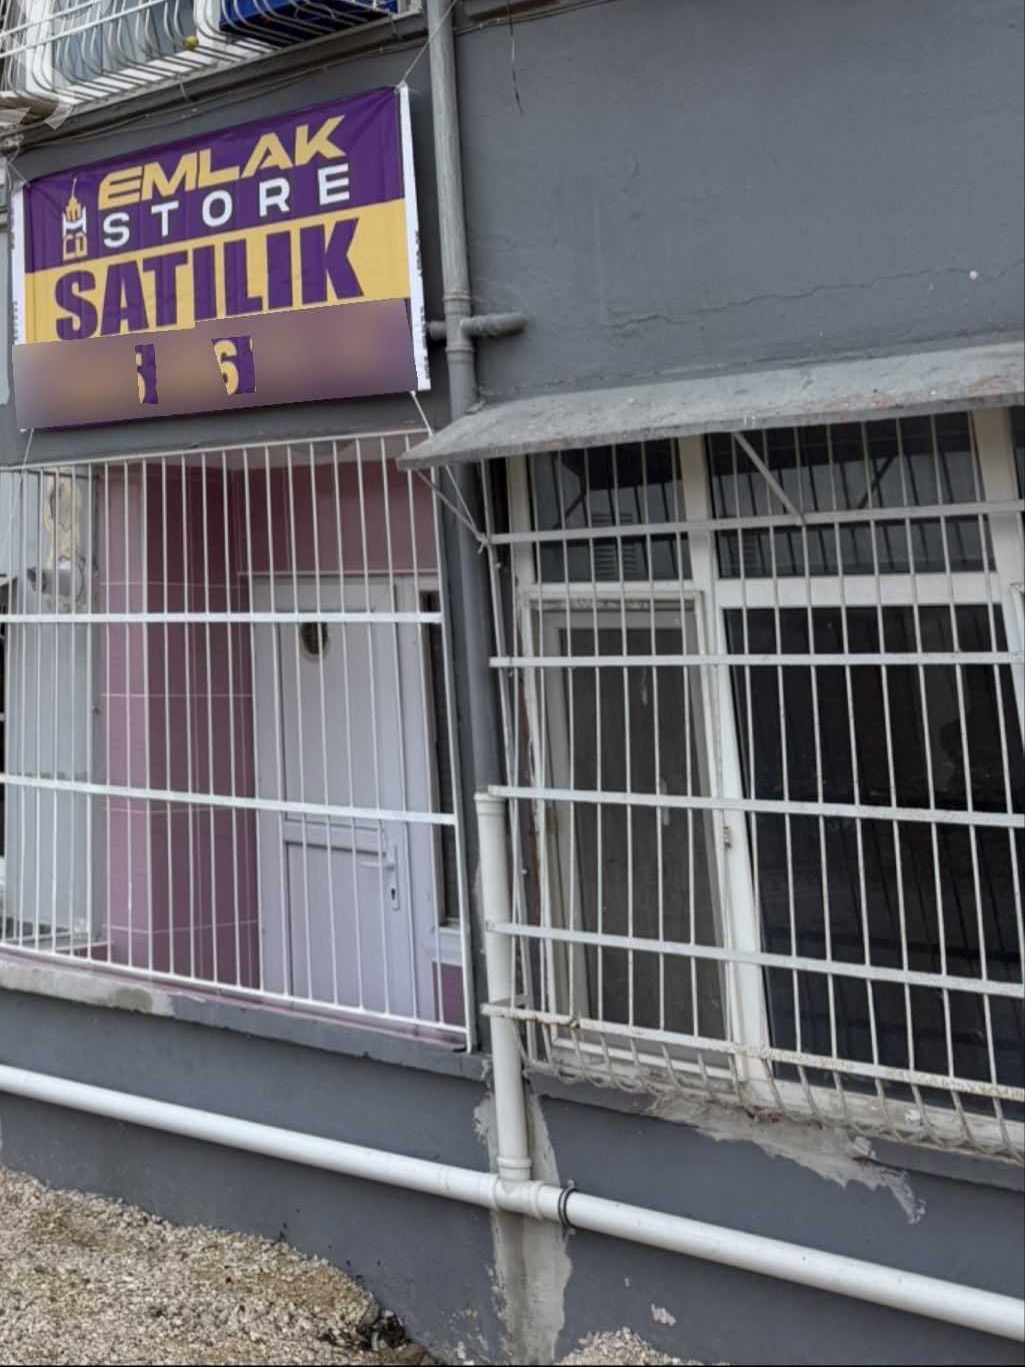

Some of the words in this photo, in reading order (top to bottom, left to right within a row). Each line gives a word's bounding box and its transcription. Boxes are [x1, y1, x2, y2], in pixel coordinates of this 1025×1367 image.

[98, 115, 347, 211] EMLAK
[103, 163, 350, 248] STORE
[54, 217, 364, 341] SATILIK
